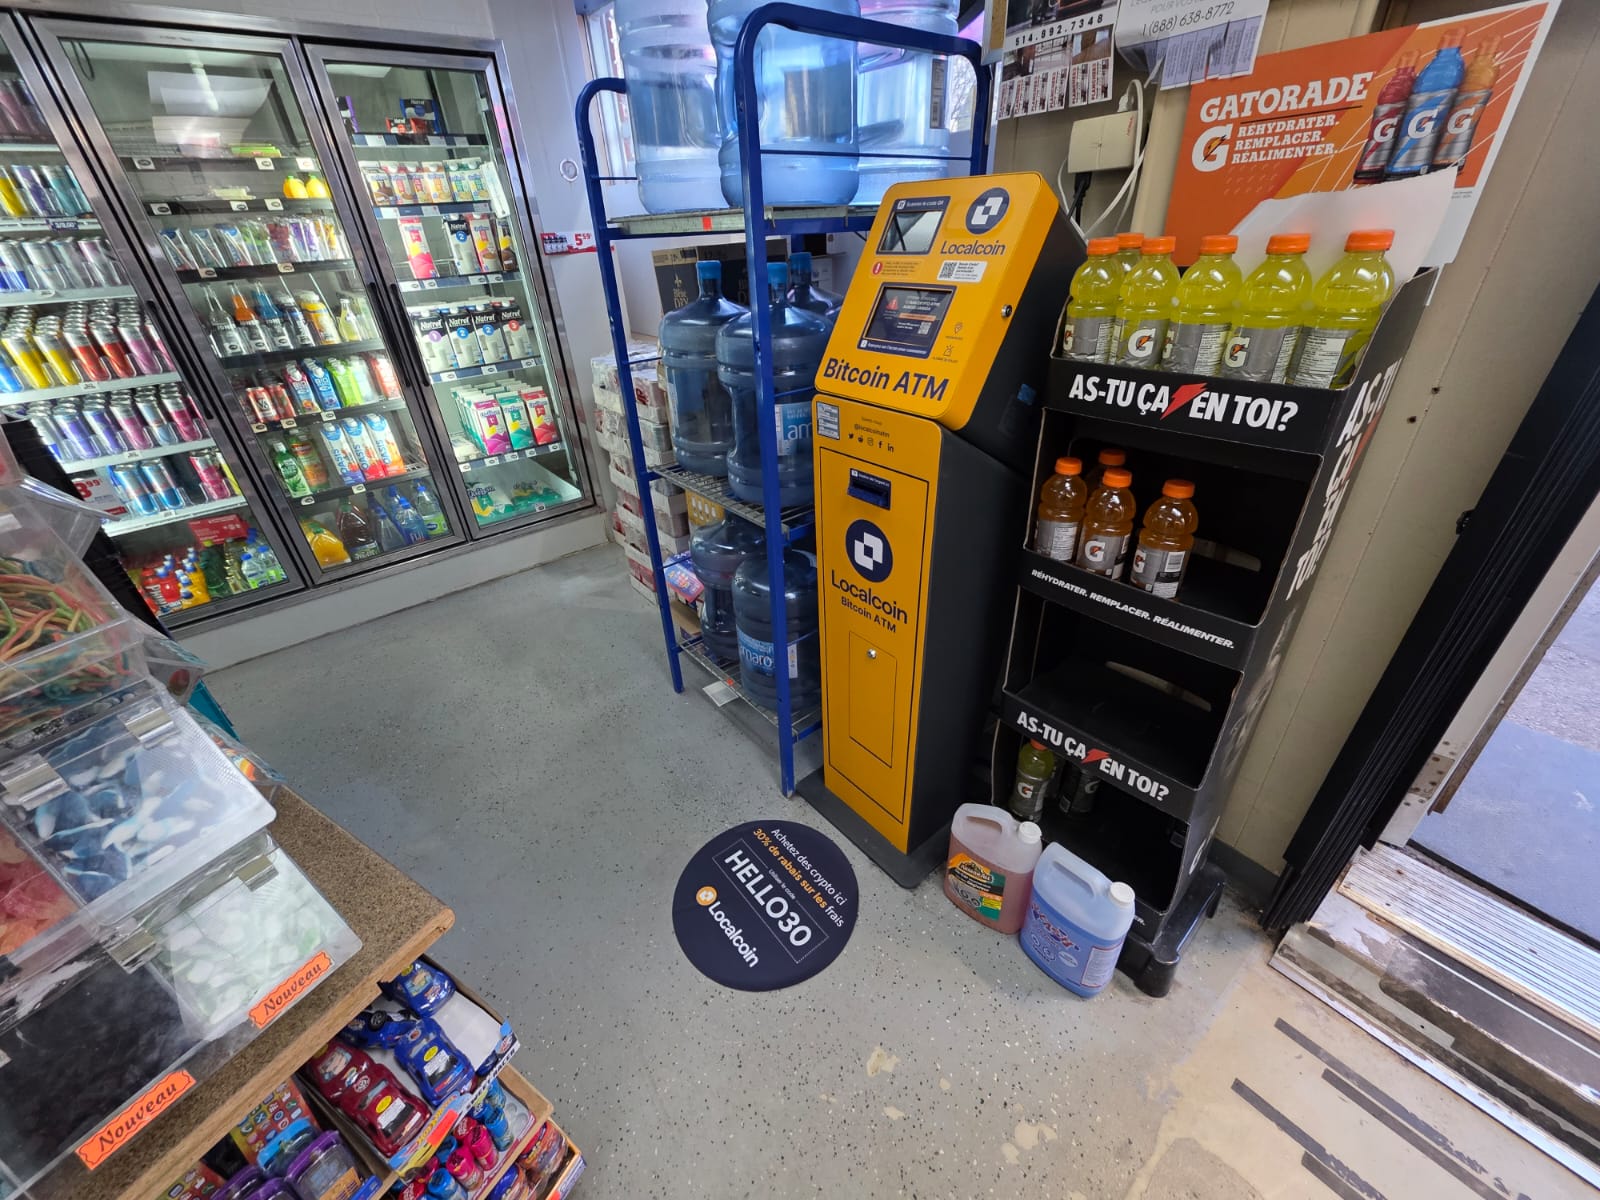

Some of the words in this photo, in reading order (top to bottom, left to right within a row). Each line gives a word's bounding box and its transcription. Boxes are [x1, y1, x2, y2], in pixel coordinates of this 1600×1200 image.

[1149, 16, 1178, 36] (888)
[1180, 1, 1235, 27] 638-8772
[1200, 72, 1374, 123] GATORADE
[1449, 106, 1475, 135] G
[1235, 130, 1325, 151] REMPLACER.
[1407, 107, 1438, 138] G
[1192, 124, 1233, 172] G
[1231, 143, 1338, 164] RÉALIMENTER.
[940, 239, 1006, 256] Localcoin
[1127, 329, 1154, 358] G
[1224, 336, 1250, 368] G
[823, 358, 890, 390] Bitcoin
[893, 371, 950, 402] ATM
[1068, 374, 1137, 407] AS-TU
[1137, 382, 1170, 415] ÇA
[1189, 391, 1233, 422] EN
[1234, 395, 1299, 431] TOI?
[1084, 540, 1106, 562] G
[831, 569, 908, 624] Localcoin
[840, 596, 872, 620] Bitcoin
[873, 614, 897, 633] ATM
[1031, 569, 1088, 597] RÉHYDRATER.
[1089, 592, 1151, 620] REMPLACER.
[1152, 614, 1235, 649] RÉALIMENTER.
[1016, 711, 1063, 746] AS-TU
[1064, 737, 1087, 760] ÇA
[1099, 758, 1126, 781] EN
[1127, 768, 1170, 802] TOI?
[1017, 782, 1033, 799] G
[753, 828, 772, 847] 30%
[768, 845, 780, 857] de
[778, 856, 802, 881] rabais
[800, 880, 816, 894] sur
[812, 892, 828, 908] les
[825, 905, 844, 927] frais
[771, 829, 800, 857] Achetez
[797, 855, 812, 870] des
[810, 869, 836, 894] crypto
[833, 892, 847, 906] ici
[724, 850, 812, 946] HELLO30
[708, 901, 759, 967] Localcoin
[262, 961, 323, 1016] Nouveau
[97, 1081, 178, 1152] Nouveau
